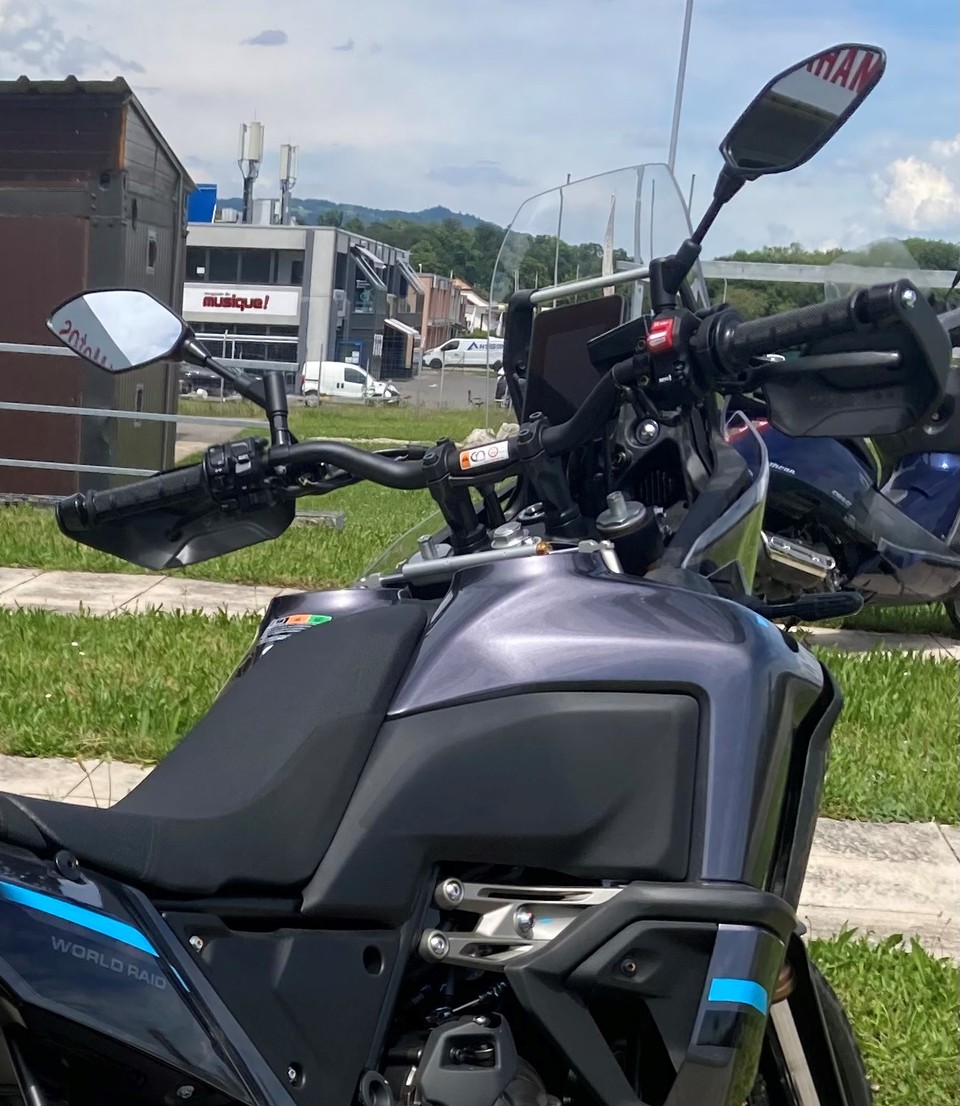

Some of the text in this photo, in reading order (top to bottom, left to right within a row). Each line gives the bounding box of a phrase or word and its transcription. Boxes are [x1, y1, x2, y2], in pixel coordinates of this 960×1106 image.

[203, 293, 270, 312] musique!
[51, 935, 167, 990] WORLD RAID
